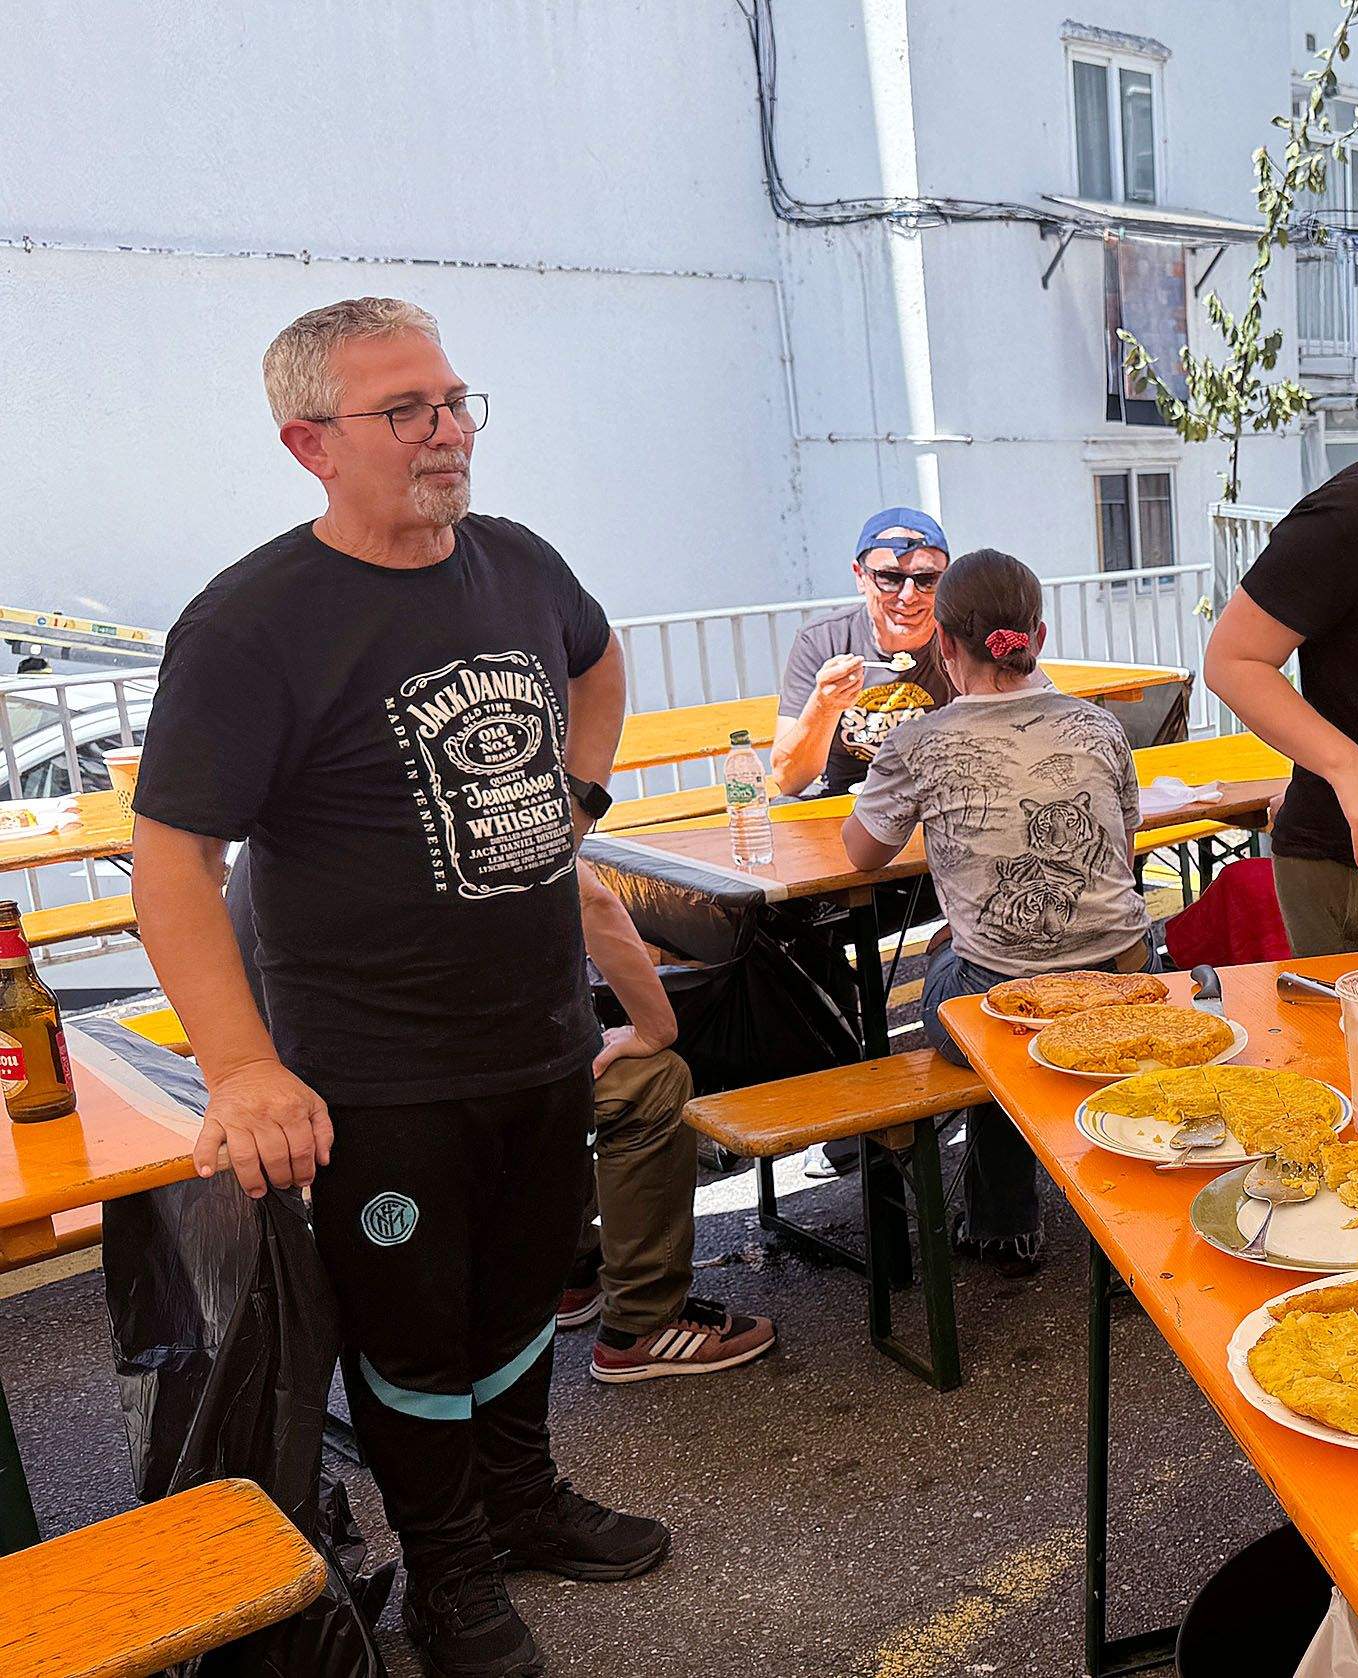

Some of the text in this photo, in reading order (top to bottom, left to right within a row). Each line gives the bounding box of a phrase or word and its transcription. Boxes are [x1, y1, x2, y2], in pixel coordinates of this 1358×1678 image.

[406, 669, 544, 739] JACK DANIEL'S
[462, 702, 512, 724] OLD TIME
[478, 724, 509, 743] Old
[484, 748, 518, 763] BRAND
[489, 769, 526, 787] QUALITY
[384, 696, 448, 893] MADE IN TENNESSEE
[461, 772, 556, 809] Tennessee
[482, 792, 551, 816] SOUR MASH
[466, 797, 565, 840] WHISKEY
[469, 845, 500, 860] JACK
[500, 838, 536, 853] DANIEL
[0, 1055, 19, 1067] ou
